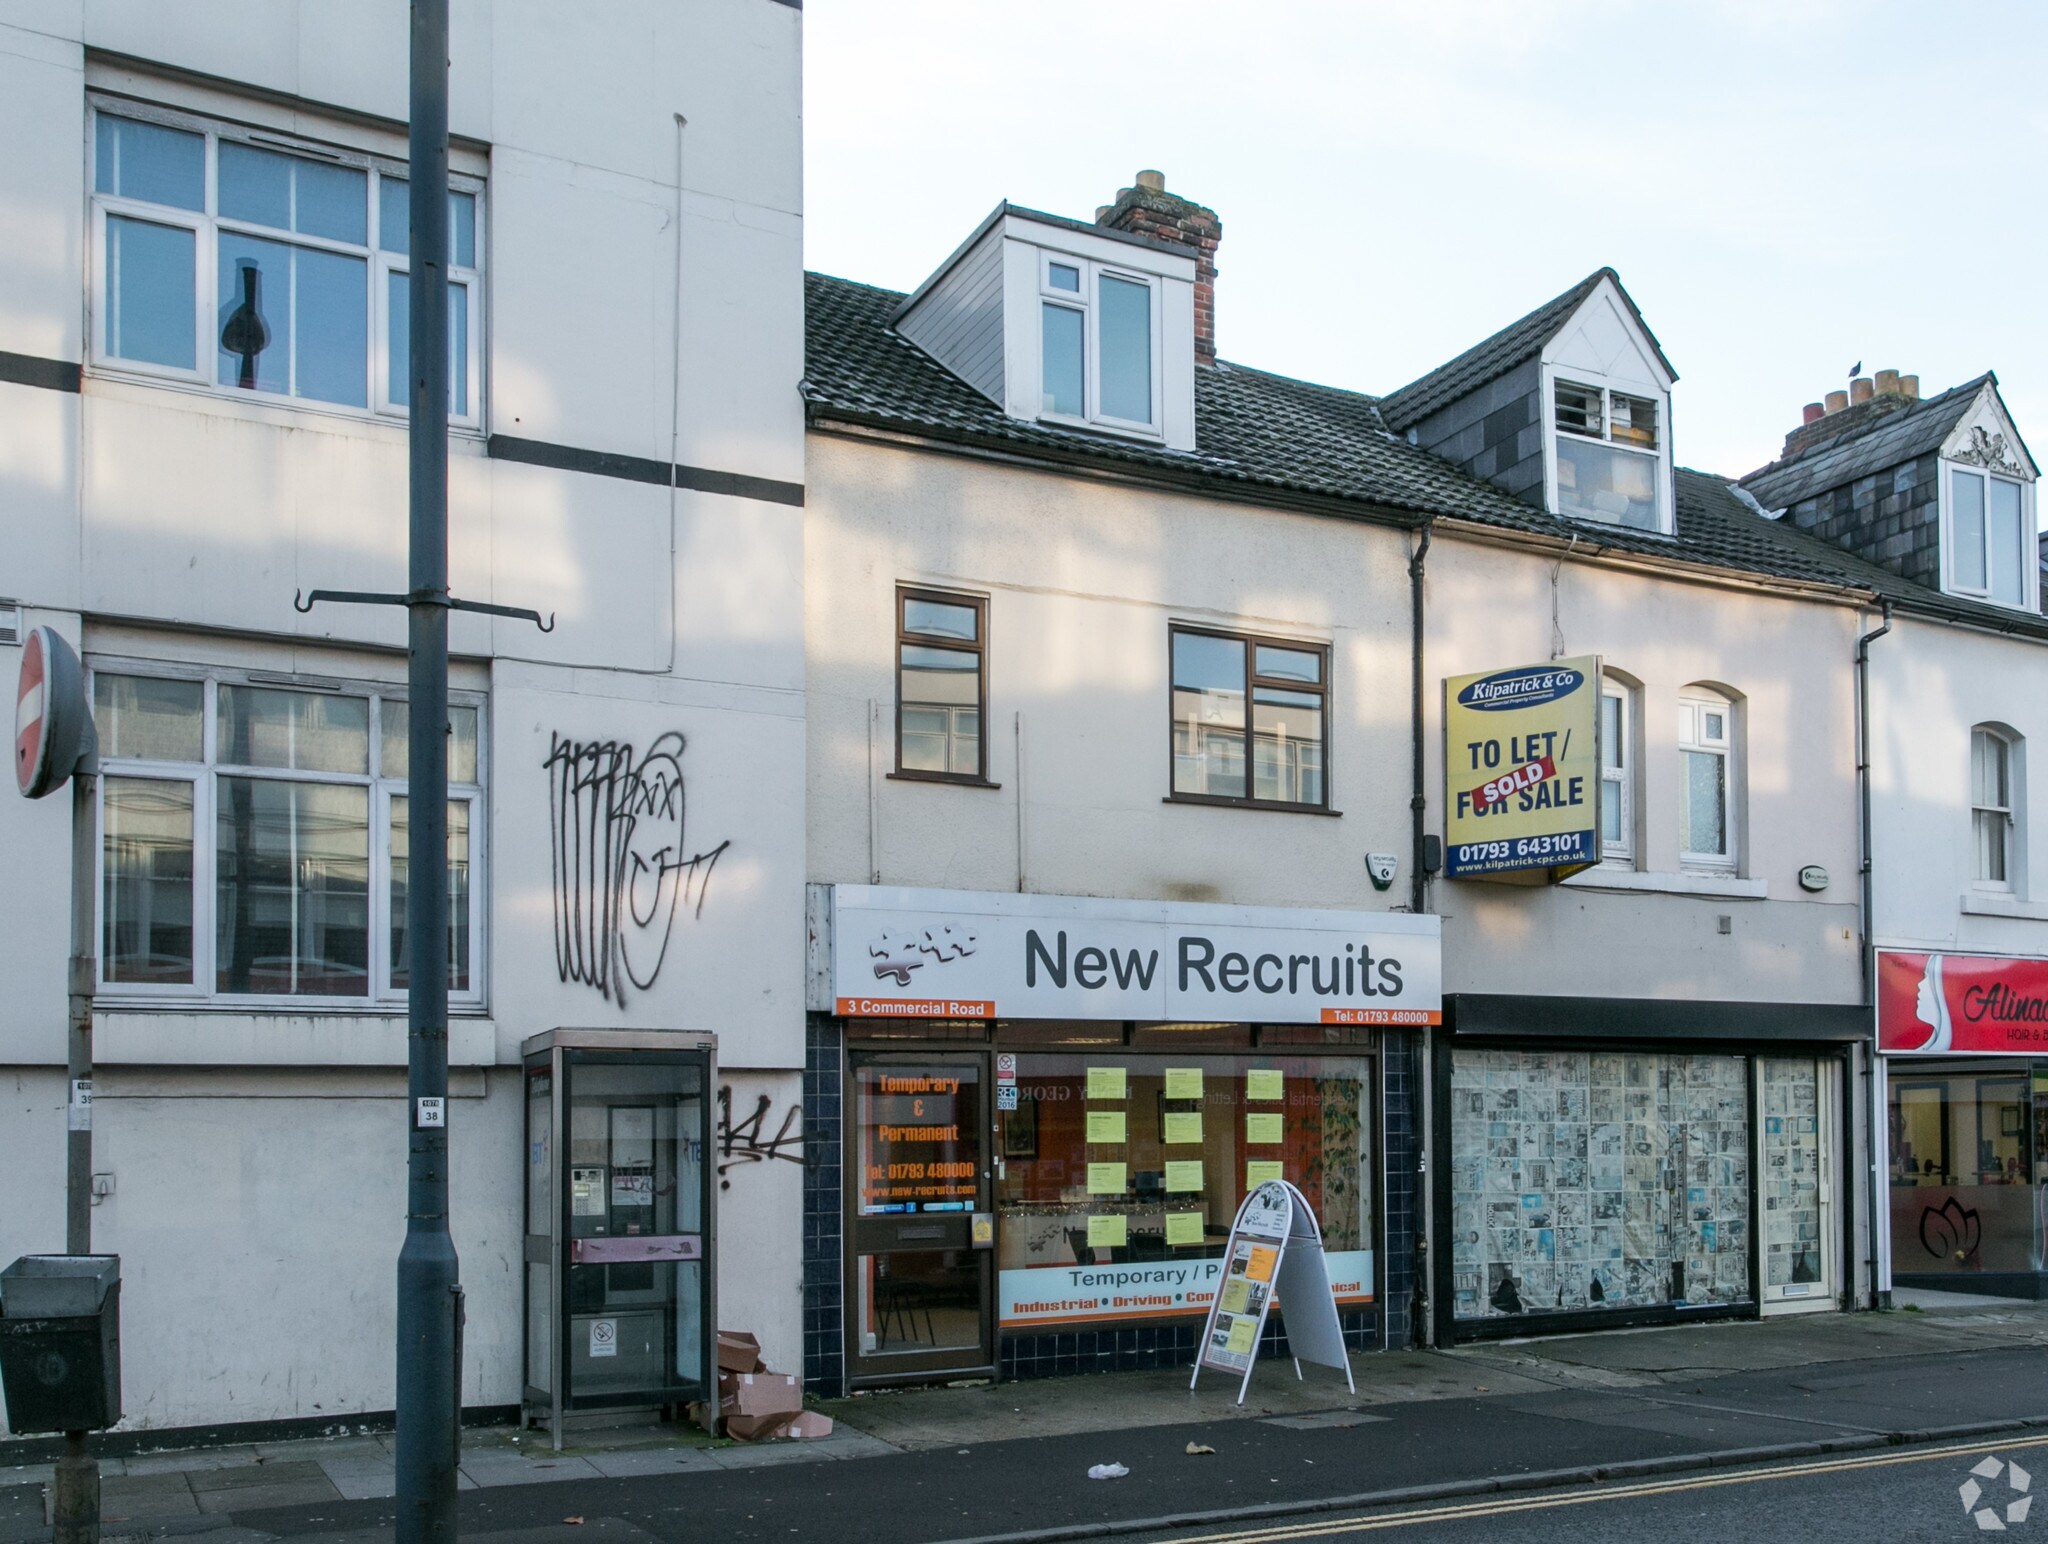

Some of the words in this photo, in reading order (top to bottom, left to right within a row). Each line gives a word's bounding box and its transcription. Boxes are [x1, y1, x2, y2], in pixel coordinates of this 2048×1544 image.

[1472, 678, 1541, 701] Kilpatrick
[1542, 675, 1554, 688] &
[1555, 673, 1574, 686] Co
[1468, 739, 1500, 770] TO
[1483, 763, 1543, 803] SOLD
[1459, 845, 1510, 862] 01793
[1517, 833, 1581, 856] 643101
[1456, 851, 1586, 872] www.kilpatrick-cpc.co.uk
[1025, 929, 1159, 992] New
[1178, 936, 1403, 997] Recruits
[848, 1000, 857, 1013] 3
[861, 1000, 945, 1015] Commercial
[949, 1003, 985, 1016] Road
[1334, 1010, 1353, 1022] Tel:
[1357, 1011, 1388, 1023] 01793
[1391, 1012, 1428, 1023] 480000
[879, 1074, 960, 1095] Temporary
[998, 1101, 1016, 1109] 2016
[425, 1111, 439, 1121] 38
[879, 1125, 959, 1142] Permanent
[888, 1163, 924, 1179] 01793
[927, 1162, 975, 1178] 480000
[1069, 1270, 1187, 1288] Temporary
[1013, 1298, 1098, 1314] Industrial
[1113, 1294, 1172, 1308] Driving
